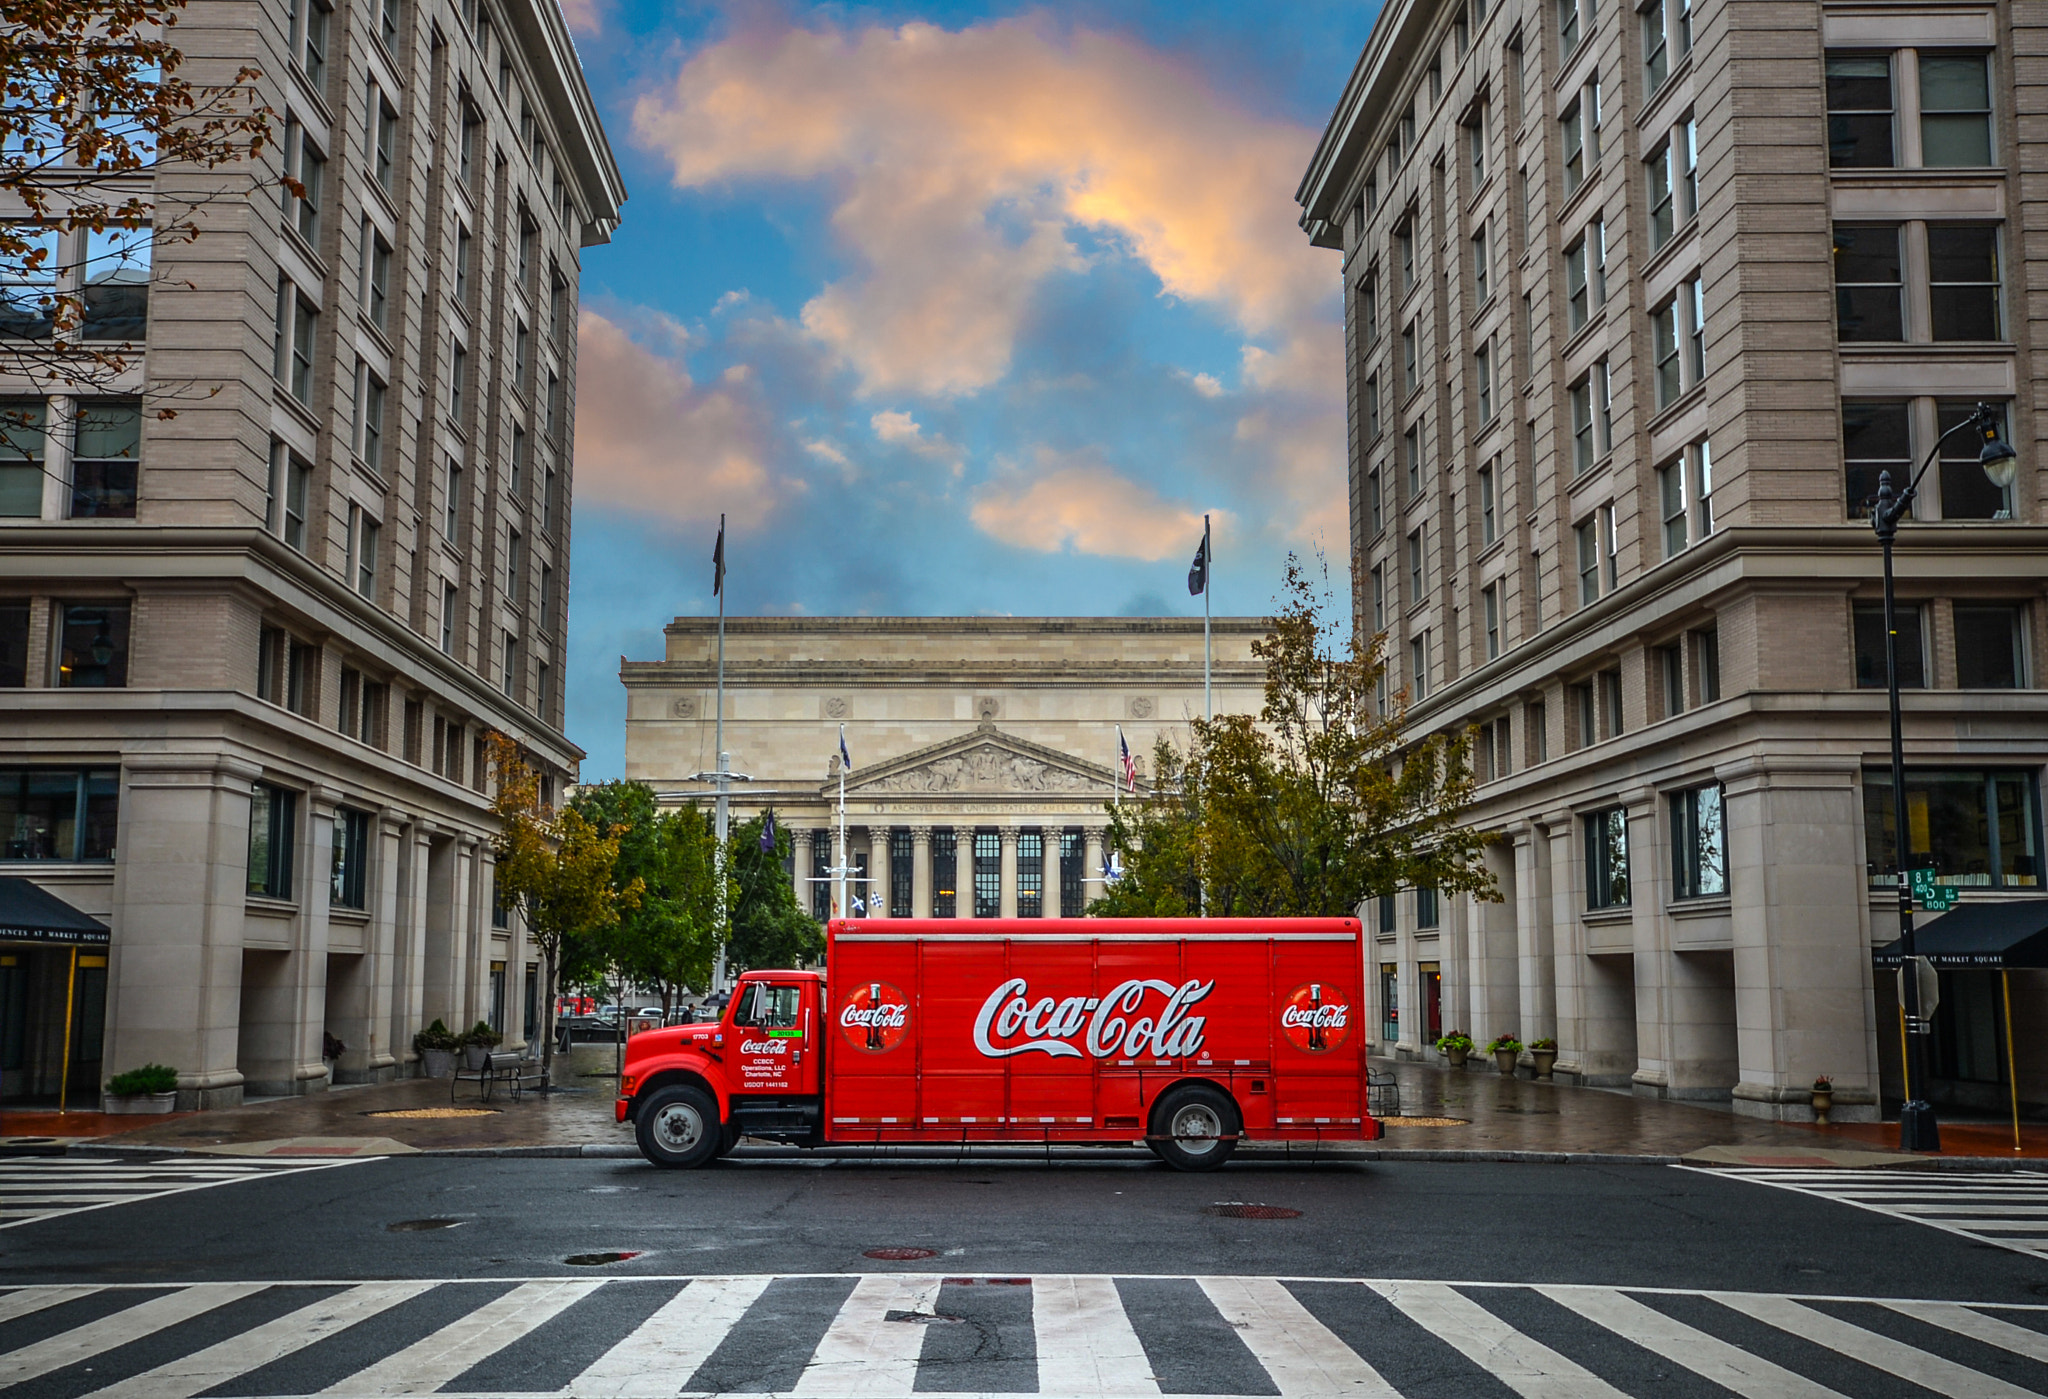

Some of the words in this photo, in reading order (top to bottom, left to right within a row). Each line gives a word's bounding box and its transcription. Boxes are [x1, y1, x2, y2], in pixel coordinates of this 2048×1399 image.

[892, 804, 933, 813] ARCHIVES
[935, 804, 946, 813] OF
[948, 804, 964, 813] THE
[966, 804, 997, 813] UNITED
[1000, 804, 1028, 813] STATES
[1030, 804, 1041, 813] OF
[1042, 804, 1082, 813] AMERICA
[1915, 872, 1921, 883] 8
[1916, 884, 1927, 893] 400
[1927, 900, 1945, 909] 800
[48, 931, 78, 939] MARKET
[1974, 956, 2004, 964] SQUARE
[840, 1003, 908, 1028] Coca-Cola
[973, 978, 1215, 1059] Coca-Cola
[1281, 1004, 1349, 1029] Coca-Cola
[740, 1038, 789, 1055] Coca-Cola
